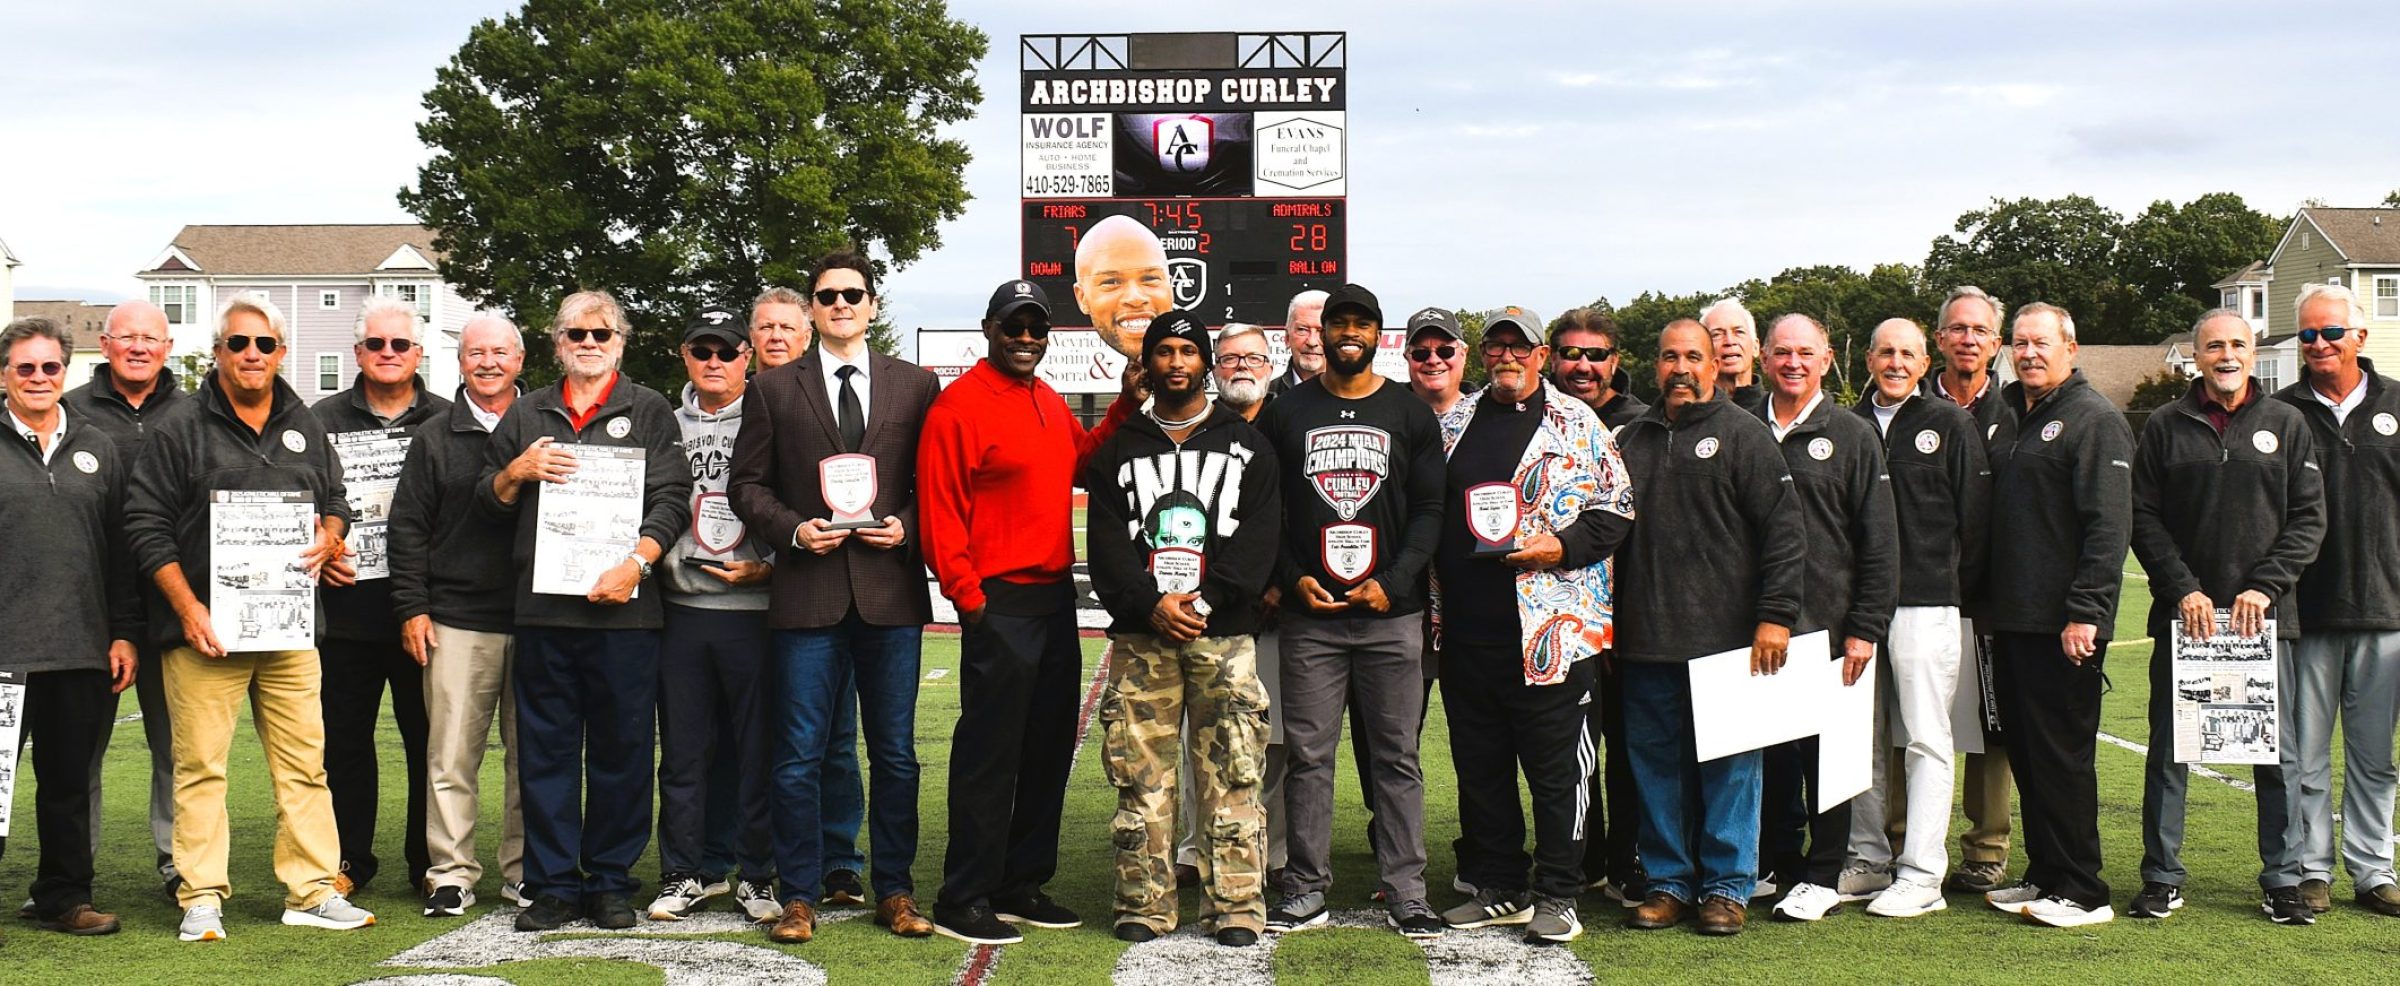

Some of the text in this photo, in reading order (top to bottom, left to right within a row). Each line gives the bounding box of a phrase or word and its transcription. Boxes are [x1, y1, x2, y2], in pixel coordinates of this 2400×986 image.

[1030, 77, 1337, 104] ARCHBISHOP CURLEY
[1030, 117, 1105, 139] WOLF
[1277, 127, 1324, 139] EVANS
[1026, 140, 1108, 149] INSURANCE AGENCY
[1271, 143, 1330, 155] Funeral Chapel
[1038, 153, 1096, 162] AUTO HOME
[1293, 156, 1308, 165] and
[1046, 163, 1090, 171] BUSINESS
[1263, 168, 1338, 177] Cremation Services
[1026, 175, 1110, 194] 410-529-7865
[1043, 205, 1086, 218] FRIARS
[1144, 202, 1203, 230] 7:45
[1273, 204, 1332, 217] ADMIRALS
[1064, 226, 1078, 250] 7
[1160, 237, 1197, 250] ERIOD
[1199, 233, 1211, 254] 2
[1290, 224, 1327, 251] 28
[1030, 262, 1062, 275] DOWN
[1289, 261, 1337, 274] BALL ON
[1224, 283, 1232, 296] 1
[1224, 306, 1234, 320] 2
[1041, 350, 1089, 364] ronin
[1089, 352, 1116, 380] &
[1045, 369, 1088, 382] Sorra
[1313, 433, 1381, 451] 2024 MIAA
[1306, 447, 1387, 477] CHAMPIONS
[1324, 477, 1371, 492] CURLEY
